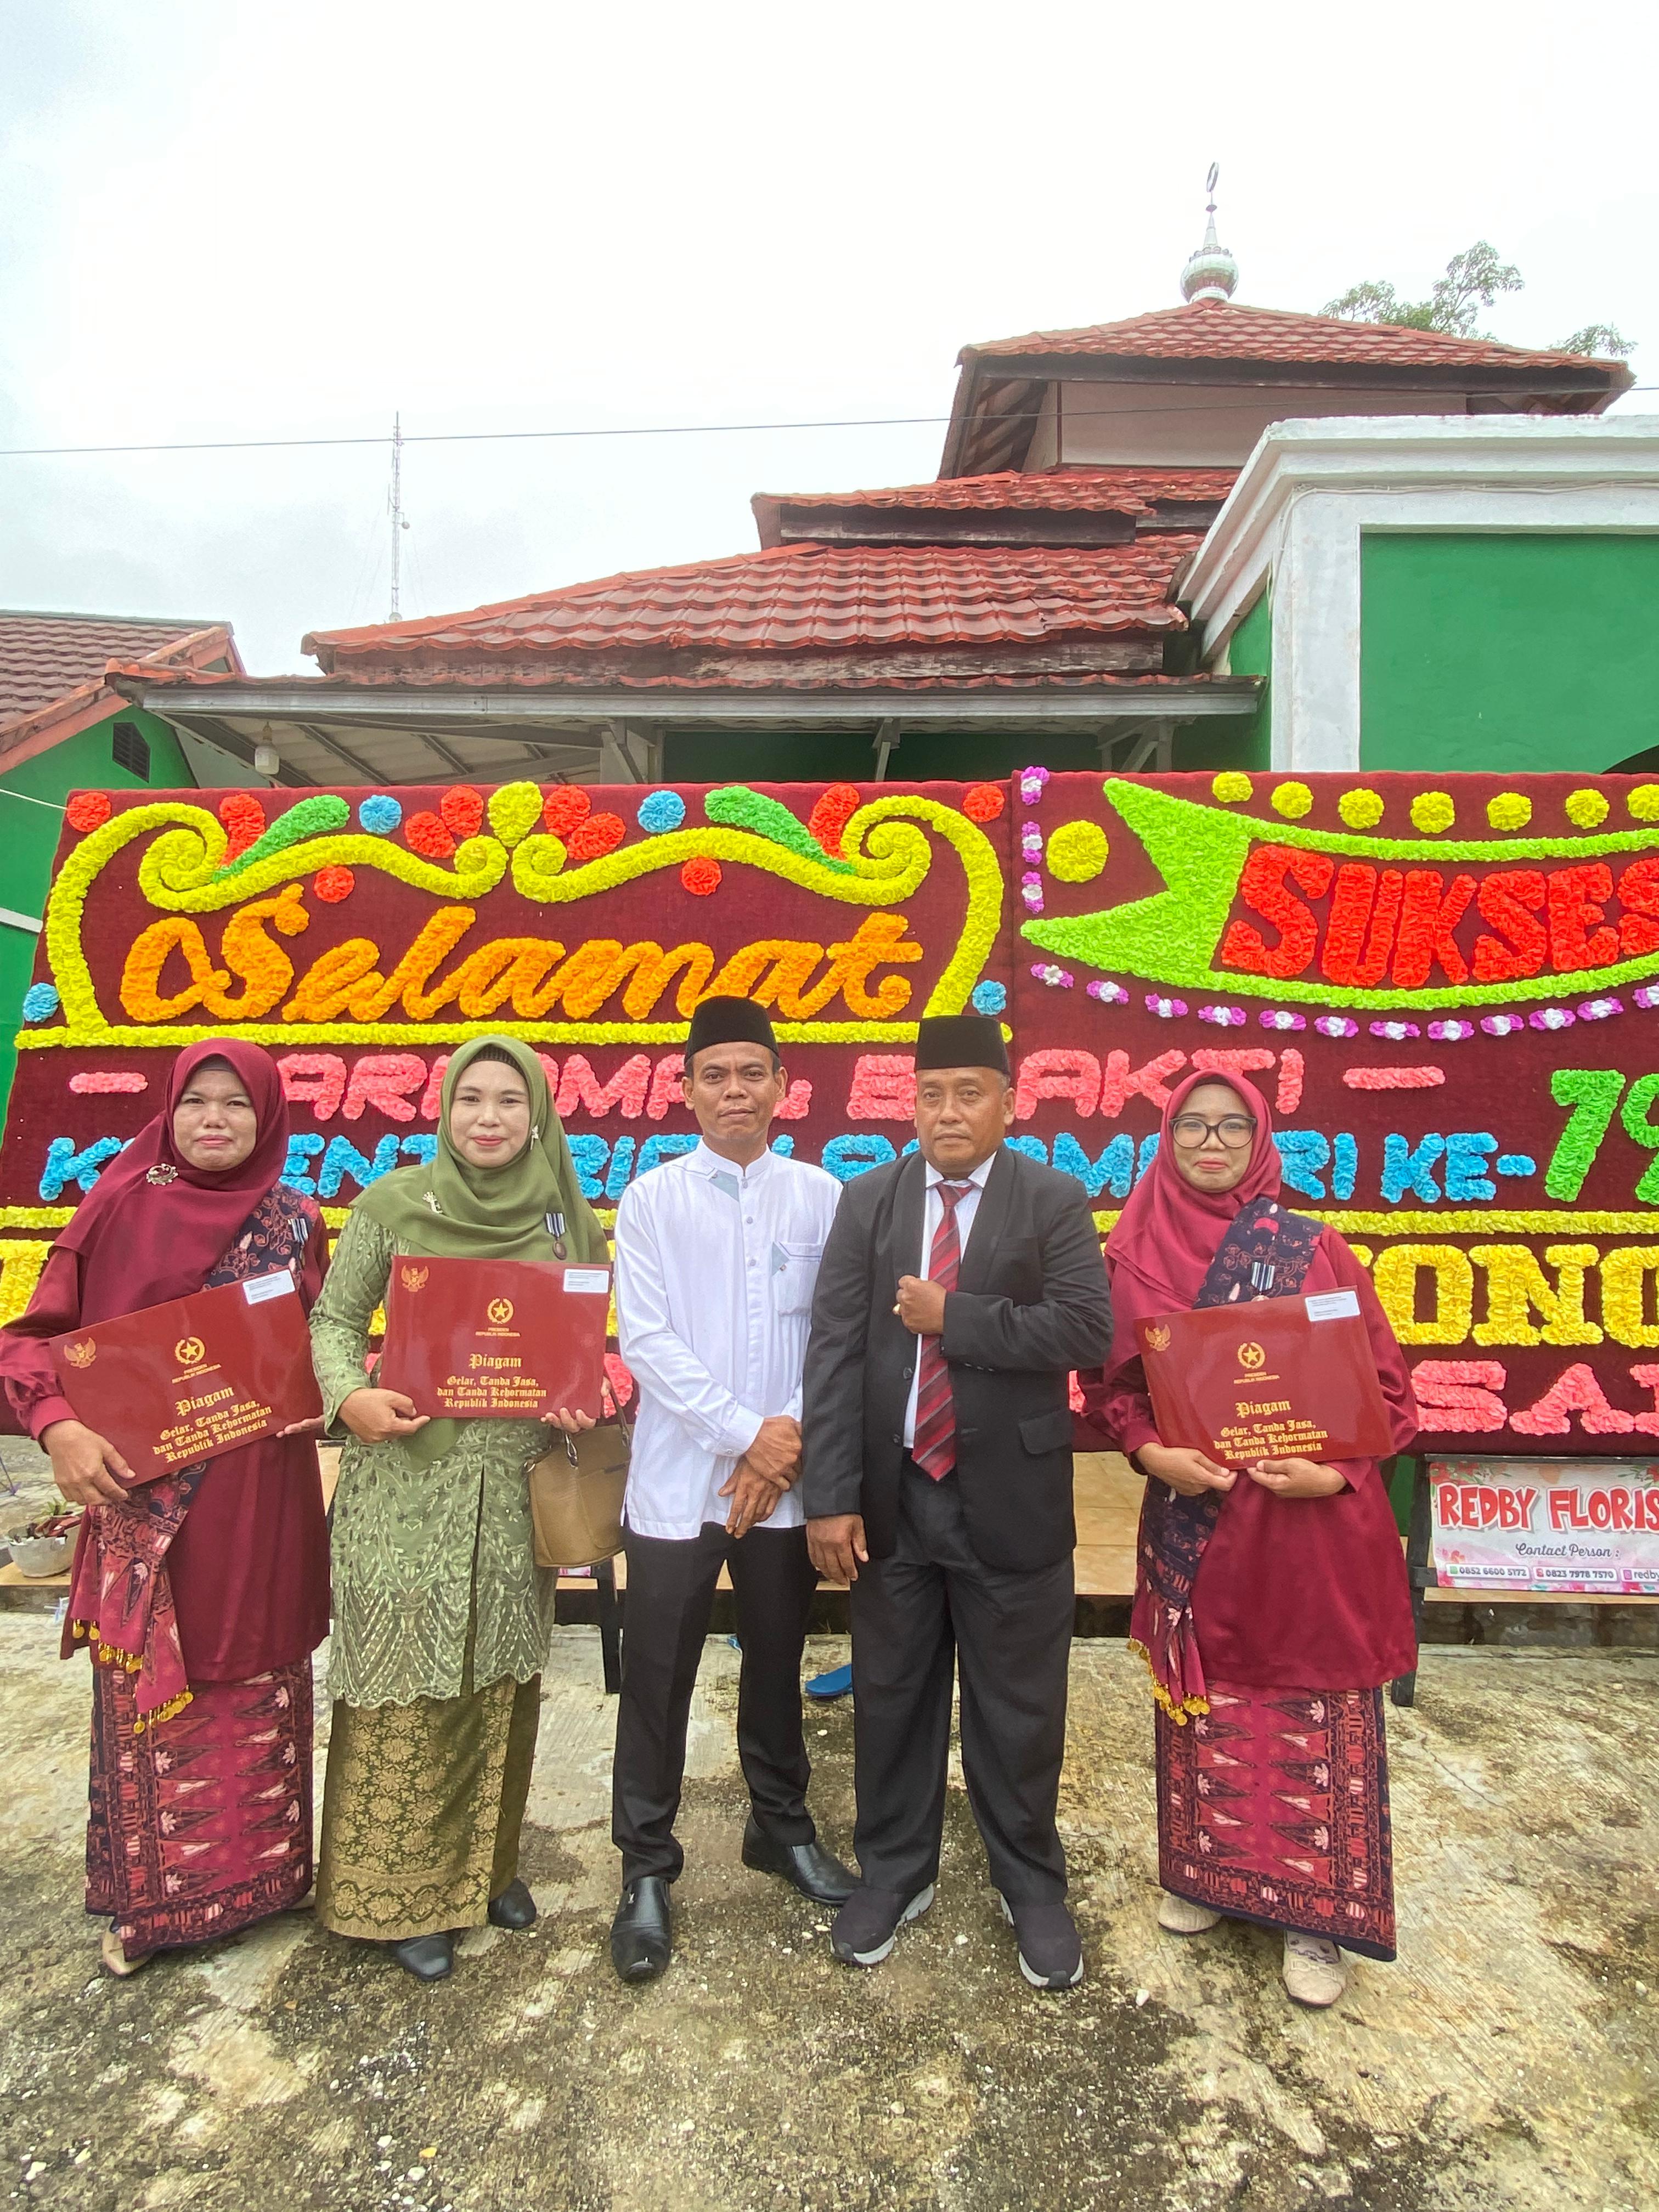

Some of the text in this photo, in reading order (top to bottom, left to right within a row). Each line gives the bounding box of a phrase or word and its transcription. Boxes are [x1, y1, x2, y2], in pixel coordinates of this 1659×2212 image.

[120, 883, 923, 1021] Selamat
[469, 1353, 522, 1369] Piagam
[447, 1375, 539, 1386] Gelar, Tanda Jasa,
[175, 1387, 234, 1417] Piagam
[437, 1387, 546, 1398] dan Tanda Kehormatan
[444, 1398, 538, 1409] Republik Indonesia
[1235, 1401, 1291, 1418] Piagam
[160, 1401, 260, 1440] Gelar, Tanda Jasa,
[1220, 1419, 1316, 1437] Gelar, Tanda Jasa,
[152, 1406, 272, 1455] dan Tanda Kehormatan
[1213, 1430, 1328, 1449] dan Tanda Kehormatan
[165, 1419, 268, 1463] Republik Indonesia
[1224, 1441, 1323, 1460] Republik Indonesia
[1438, 1483, 1538, 1531] REDBY
[1516, 1543, 1567, 1555] Contact
[1569, 1544, 1612, 1556] Person
